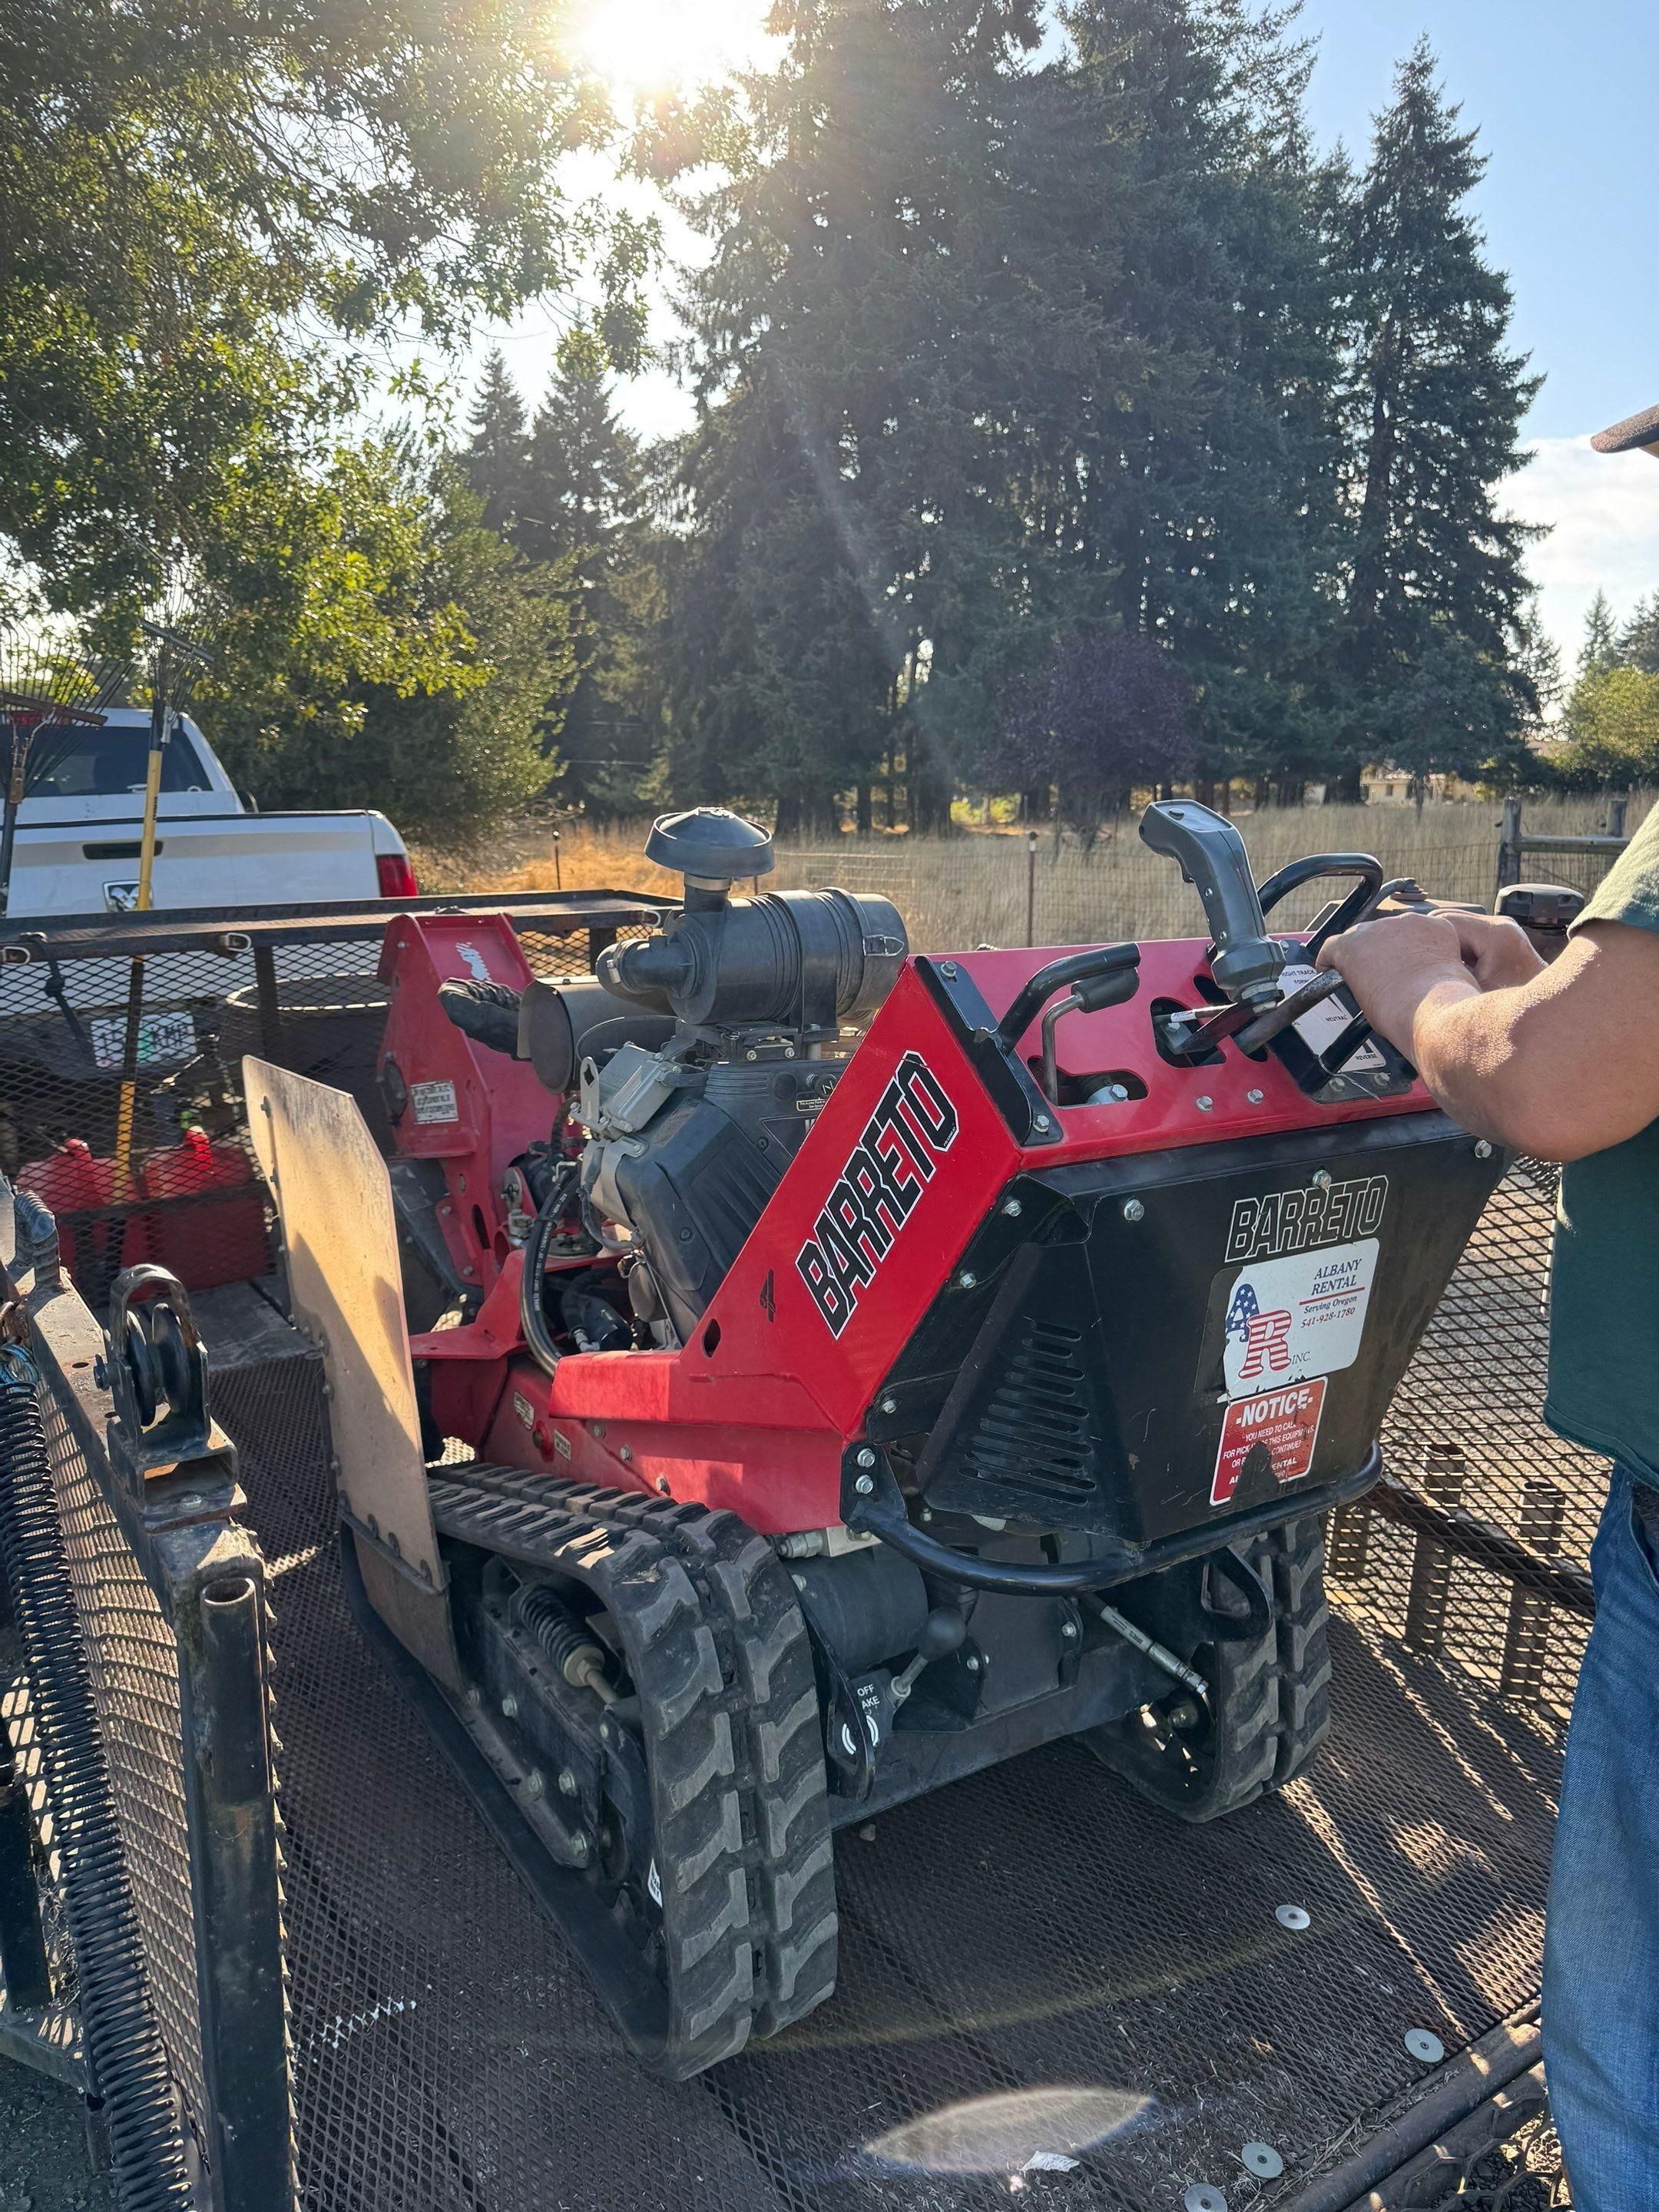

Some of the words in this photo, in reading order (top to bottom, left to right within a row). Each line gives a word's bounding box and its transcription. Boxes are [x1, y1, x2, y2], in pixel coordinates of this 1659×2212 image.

[794, 1049, 959, 1341] BARRETO
[1224, 1174, 1389, 1263] BARRETO
[1314, 1259, 1363, 1280] ALBANY
[1311, 1275, 1358, 1296] RENTAL
[1303, 1302, 1331, 1314] Serving
[1333, 1296, 1358, 1308] Oregon
[1301, 1307, 1356, 1329] 541-928-1780
[1292, 1351, 1312, 1365] INC.
[1257, 1426, 1274, 1439] NEED
[1275, 1424, 1283, 1433] TO
[1223, 1449, 1236, 1460] FOR
[1269, 1435, 1282, 1445] THIS
[1231, 1458, 1241, 1469] OR
[856, 1684, 875, 1697] OFF
[861, 1695, 880, 1710] AKE
